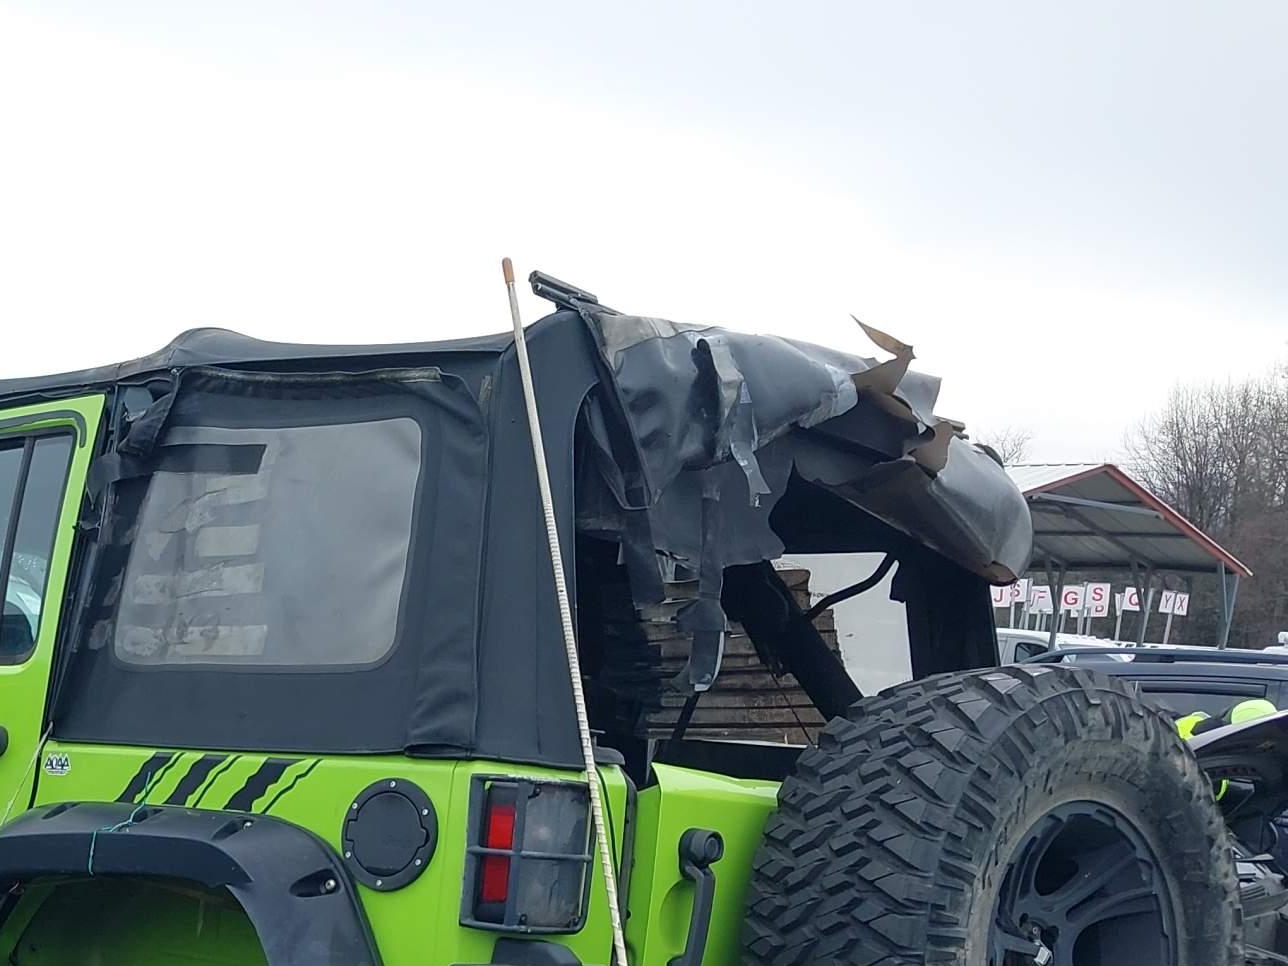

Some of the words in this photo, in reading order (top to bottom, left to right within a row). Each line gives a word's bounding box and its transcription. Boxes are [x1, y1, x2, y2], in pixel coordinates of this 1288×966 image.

[994, 588, 1004, 603] J
[1064, 591, 1078, 605] G
[1092, 587, 1104, 601] S
[1165, 594, 1172, 608] Y
[1177, 596, 1186, 611] X
